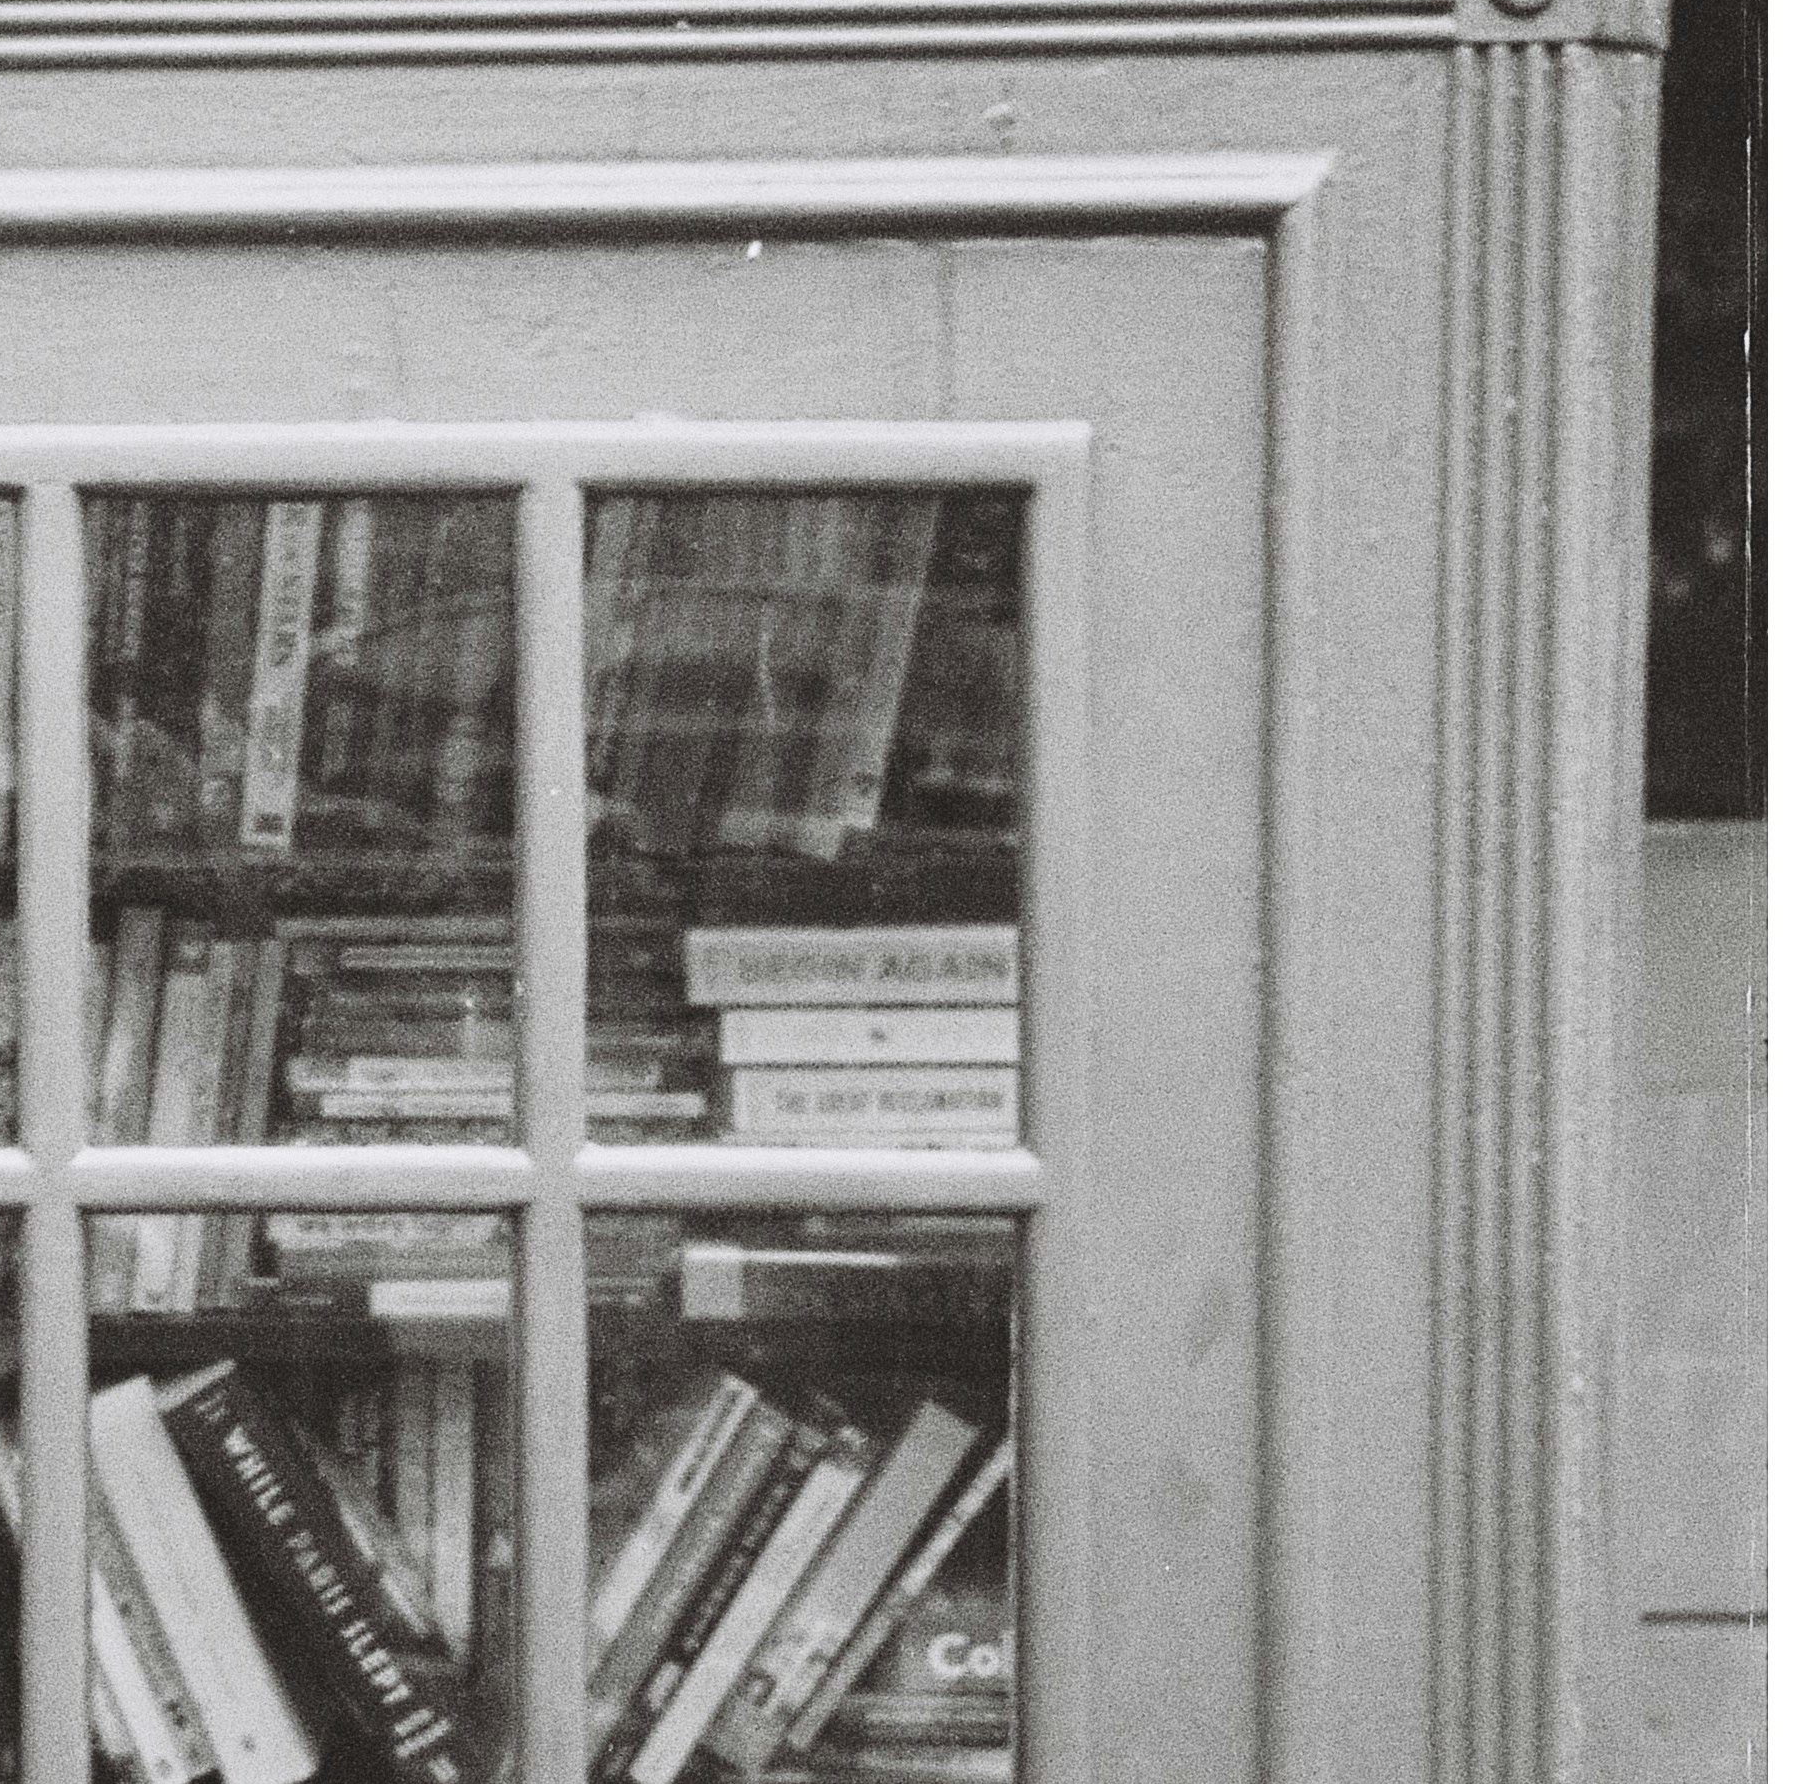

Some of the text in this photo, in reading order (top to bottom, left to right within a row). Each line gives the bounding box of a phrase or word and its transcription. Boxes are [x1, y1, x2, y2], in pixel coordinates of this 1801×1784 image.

[737, 950, 1010, 985] BEGIN AGAIN
[221, 1423, 412, 1705] WHILE PARIS SLEPT
